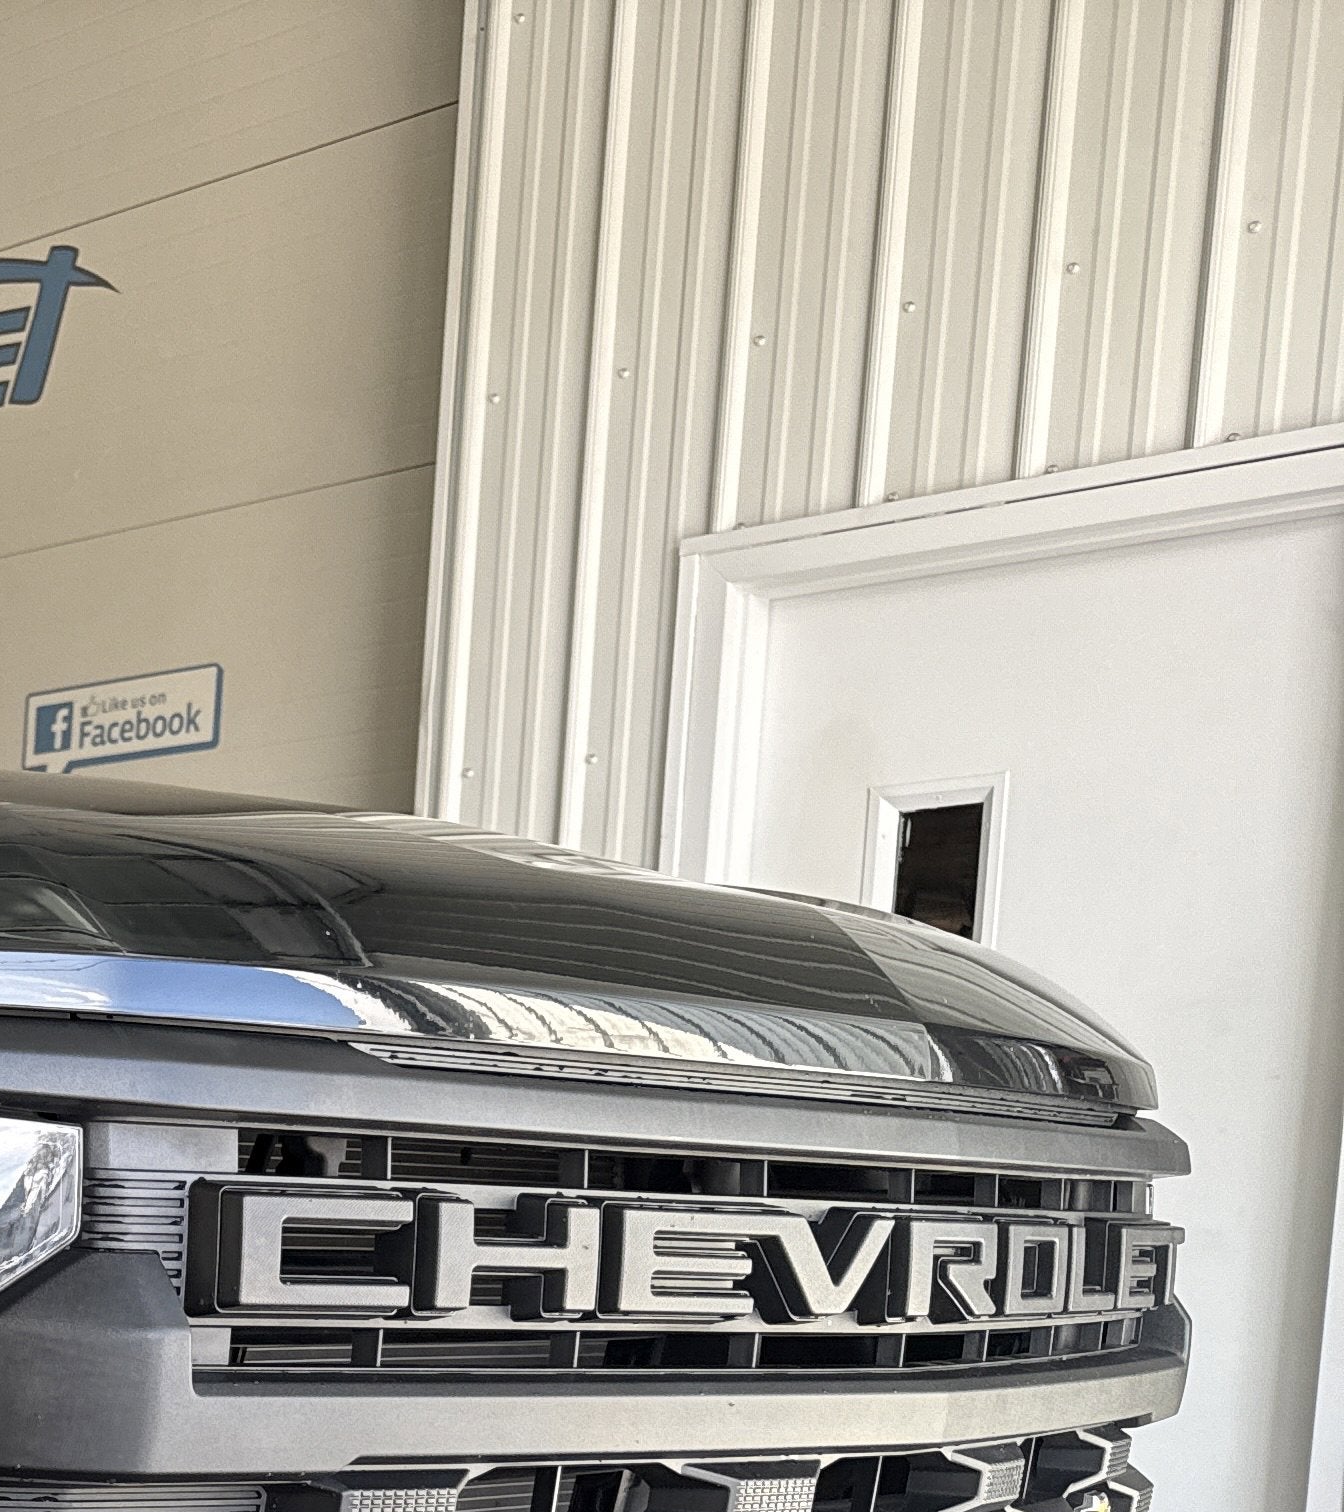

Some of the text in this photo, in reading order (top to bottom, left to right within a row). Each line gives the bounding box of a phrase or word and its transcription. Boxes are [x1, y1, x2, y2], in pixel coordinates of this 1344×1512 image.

[78, 702, 203, 750] Facebook
[101, 692, 168, 714] Like us on
[205, 1185, 1186, 1323] CHEVROLET
